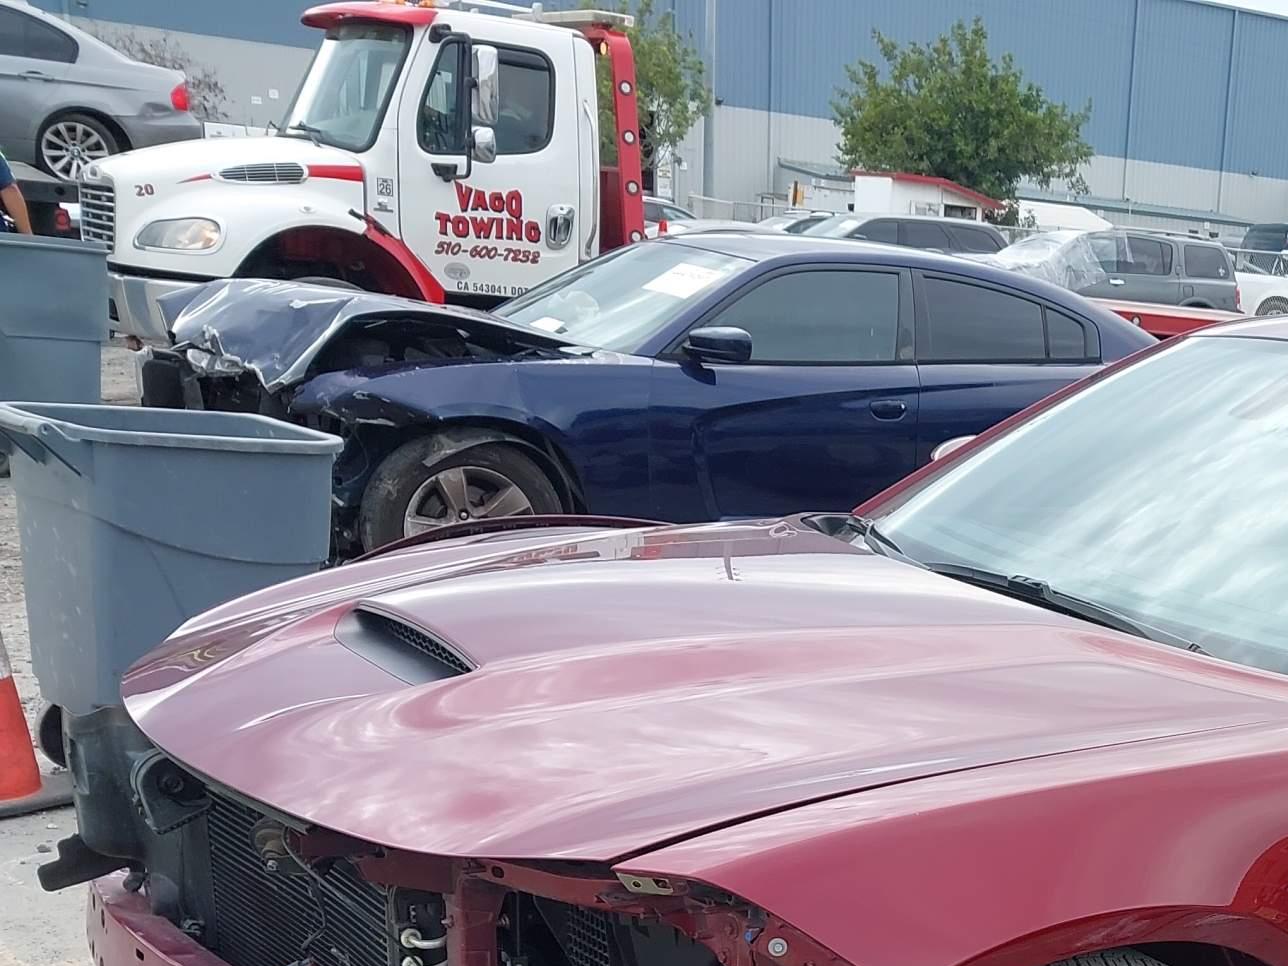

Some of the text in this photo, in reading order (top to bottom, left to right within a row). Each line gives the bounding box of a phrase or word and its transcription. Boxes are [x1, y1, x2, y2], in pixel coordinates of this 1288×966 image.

[134, 183, 155, 197] 20
[380, 183, 391, 195] 26
[454, 180, 523, 219] VAGO
[434, 211, 541, 243] TOWING
[457, 281, 469, 292] CA
[473, 282, 508, 295] 543041
